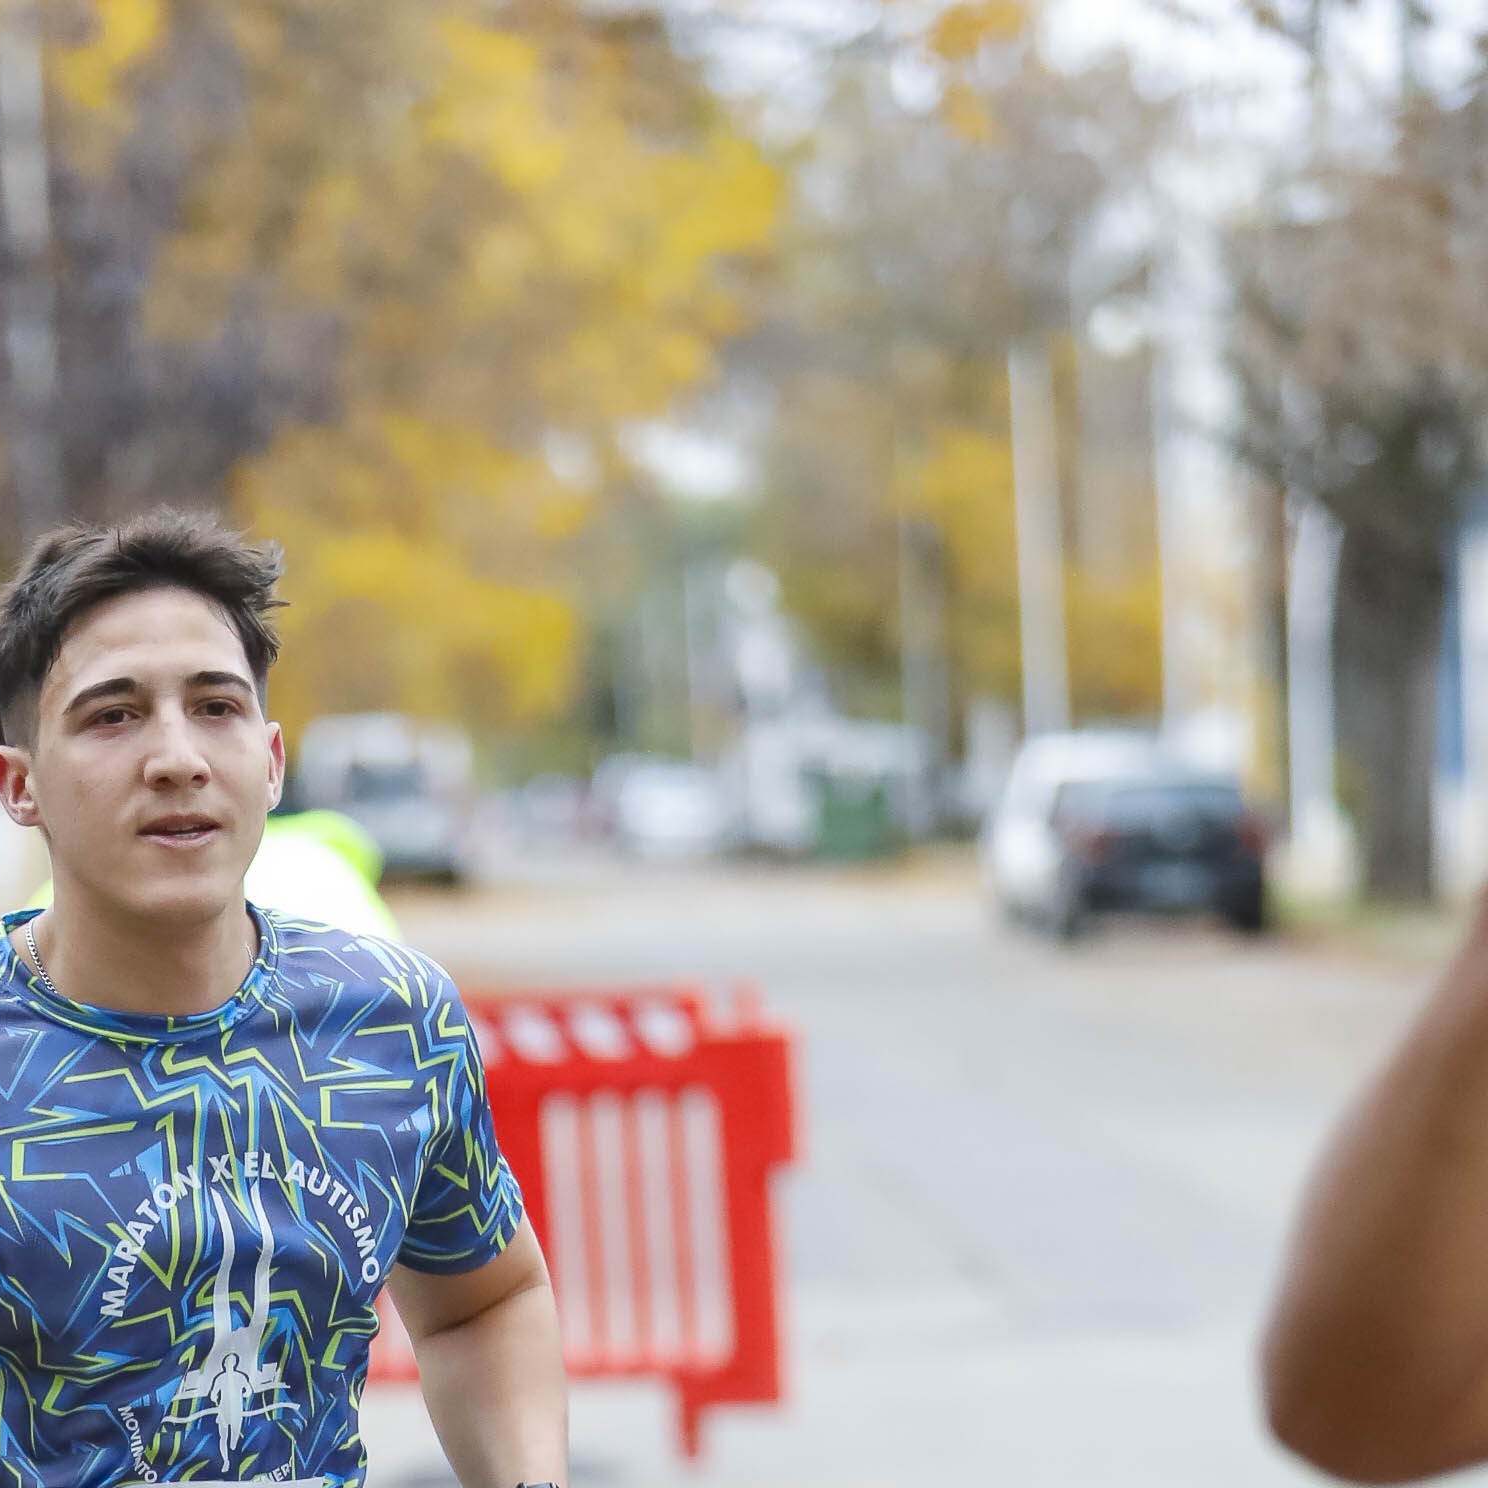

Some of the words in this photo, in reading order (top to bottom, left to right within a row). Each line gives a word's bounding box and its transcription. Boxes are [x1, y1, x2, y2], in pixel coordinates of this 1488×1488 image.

[100, 1163, 202, 1318] MARATÓN
[207, 1153, 234, 1183] X
[244, 1151, 276, 1180] EL
[283, 1159, 380, 1284] AUTISMO
